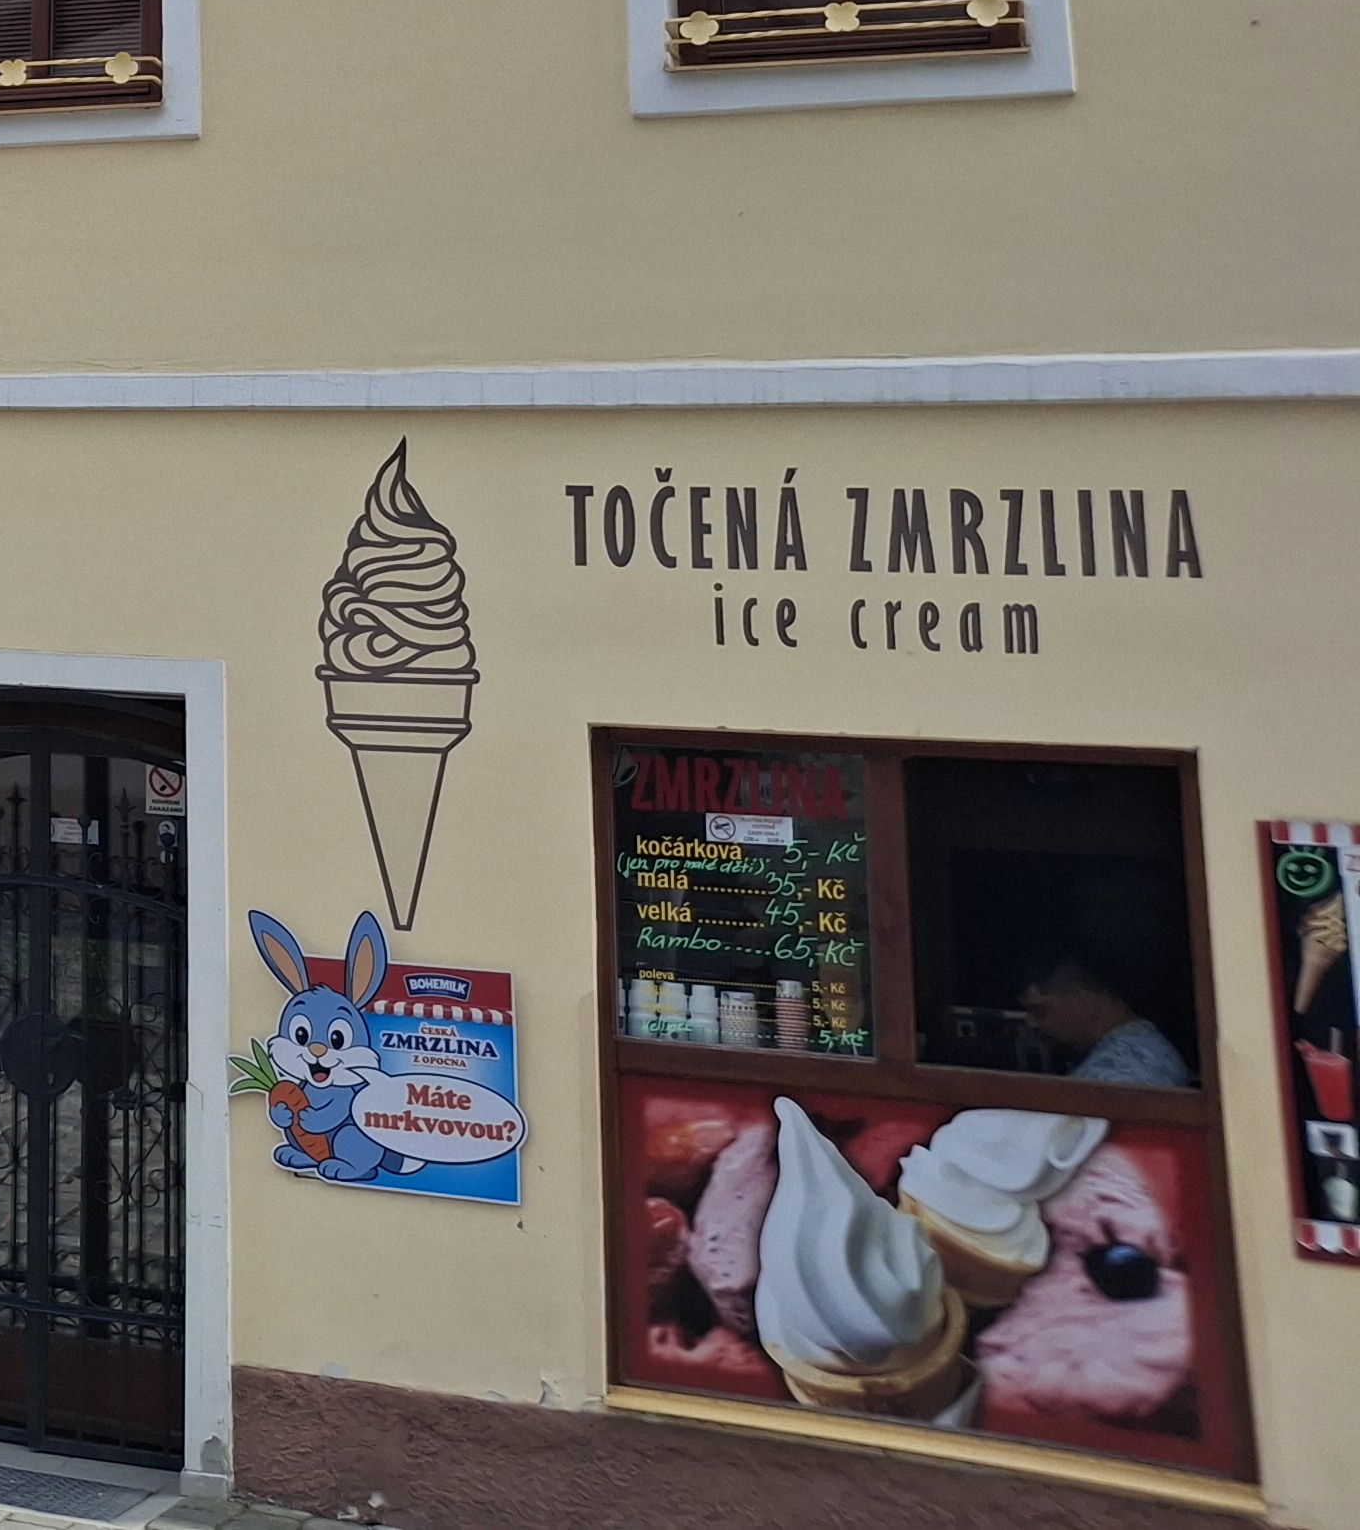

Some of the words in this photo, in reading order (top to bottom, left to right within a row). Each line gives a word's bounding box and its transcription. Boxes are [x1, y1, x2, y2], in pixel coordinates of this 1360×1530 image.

[565, 467, 808, 571] TOČENÁ
[846, 487, 1204, 579] ZMRZLINA
[713, 582, 799, 648] ice
[850, 598, 1040, 655] cream
[630, 754, 849, 820] ZMRZLINA
[826, 832, 868, 865] Kč
[653, 857, 679, 874] pro
[636, 868, 689, 890] malá
[817, 878, 847, 901] Kč
[636, 901, 692, 923] velká
[818, 912, 848, 934] Kč
[636, 926, 722, 951] Rambo
[408, 977, 468, 995] BOHEMILK
[638, 968, 675, 981] poleva
[381, 1032, 499, 1058] ZMRZLINA
[420, 1023, 458, 1038] ČESKÁ
[412, 1055, 421, 1064] Z
[422, 1054, 468, 1068] OPOČNA
[406, 1082, 472, 1111] Máte
[363, 1110, 517, 1143] mrkvovou?
